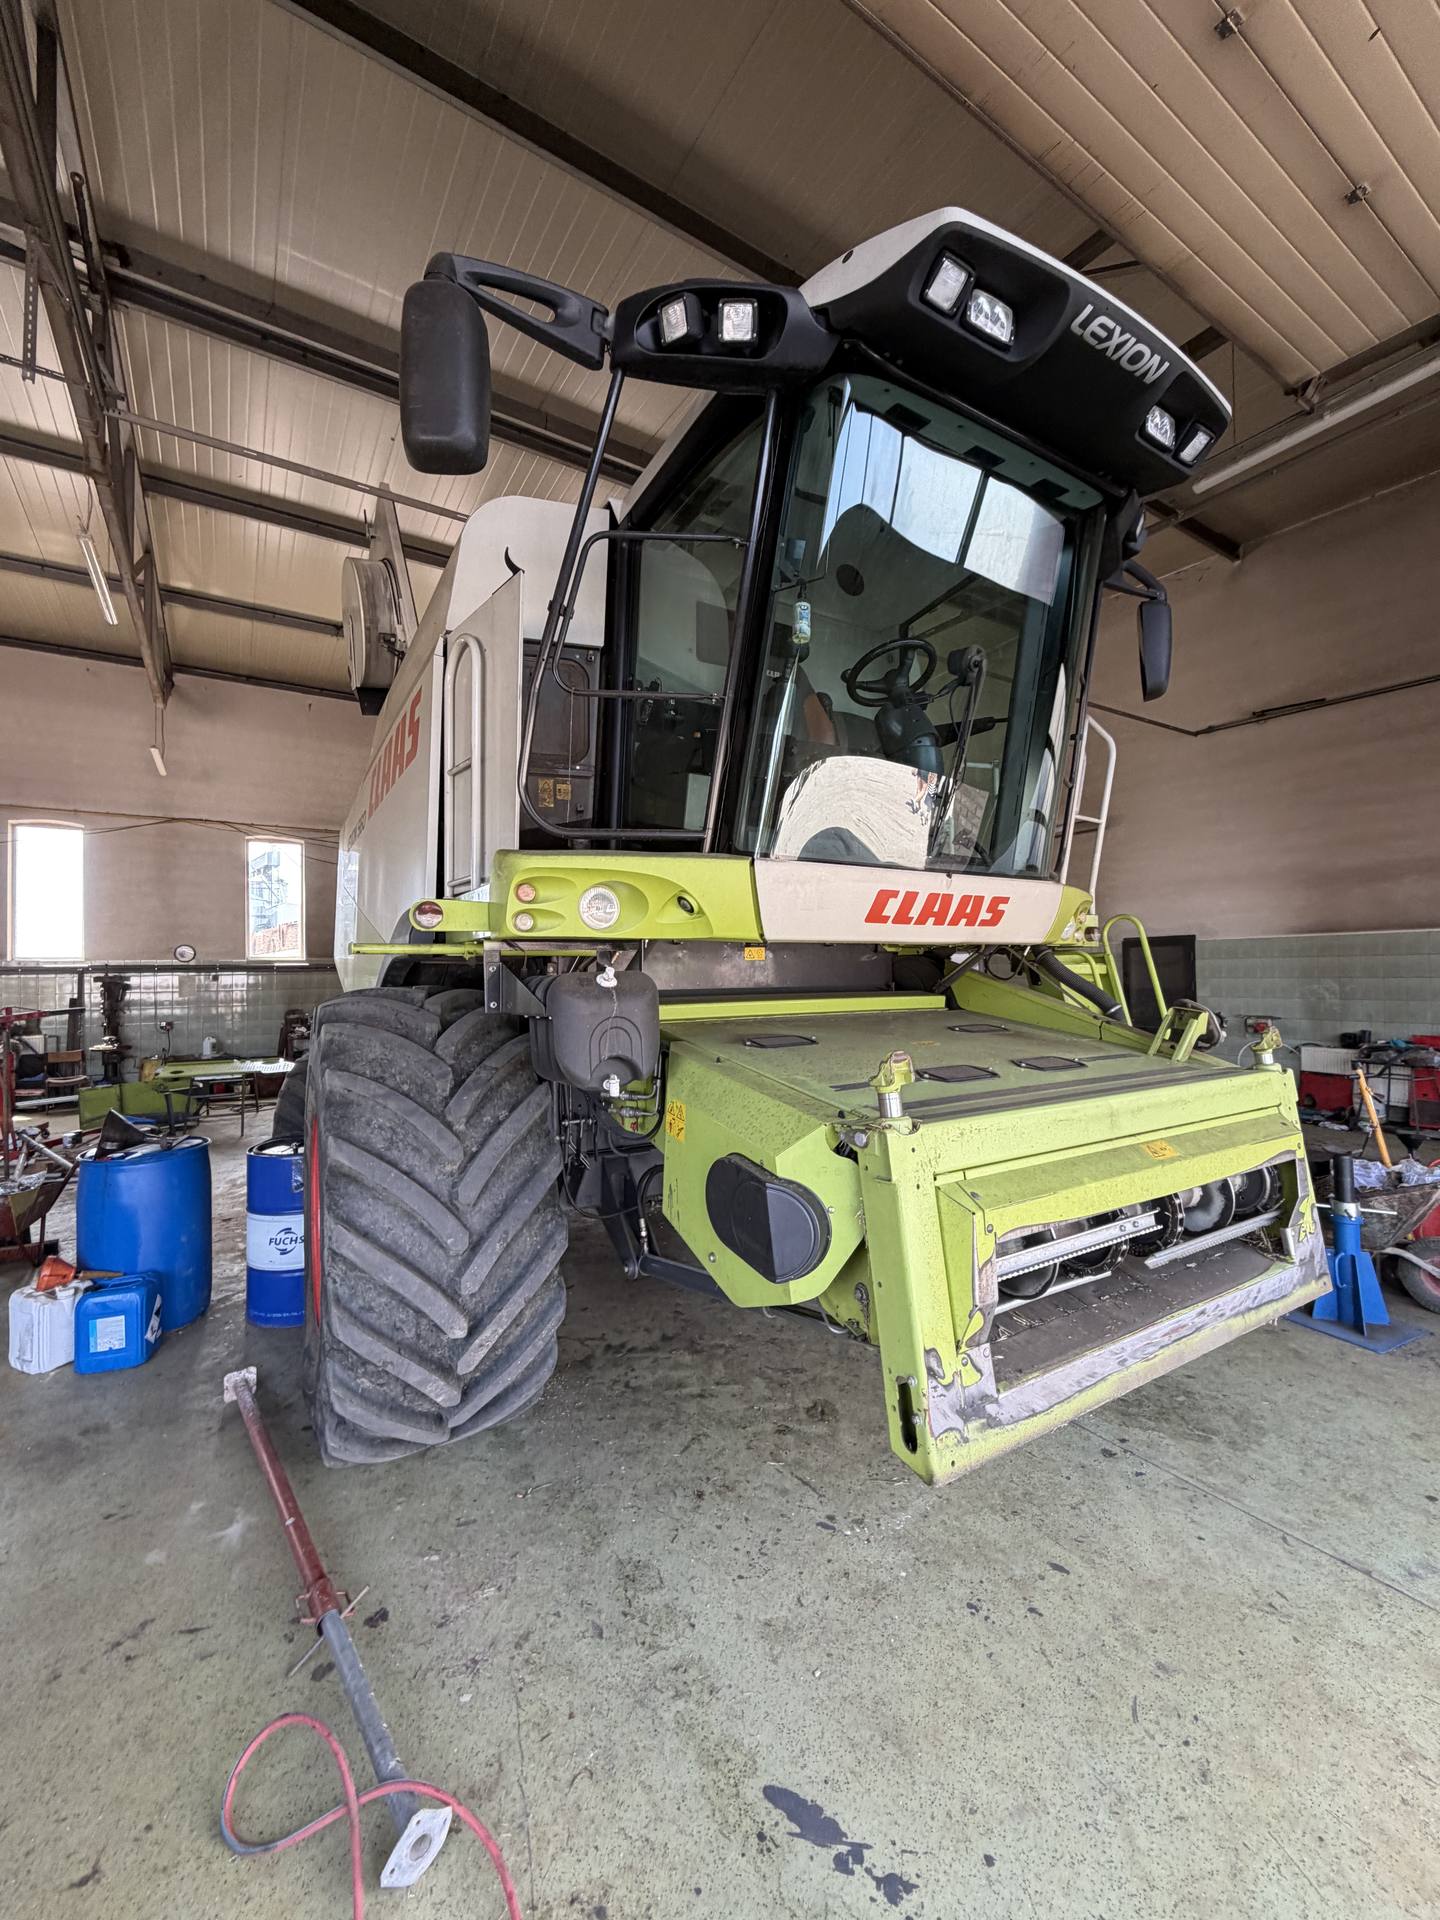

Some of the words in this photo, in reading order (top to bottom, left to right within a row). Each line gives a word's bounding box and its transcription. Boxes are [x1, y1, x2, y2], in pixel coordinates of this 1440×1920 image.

[1070, 303, 1170, 385] LEXION
[368, 685, 423, 820] CLAAS
[864, 889, 1011, 928] CLAAS
[268, 1235, 305, 1246] FUCHS
